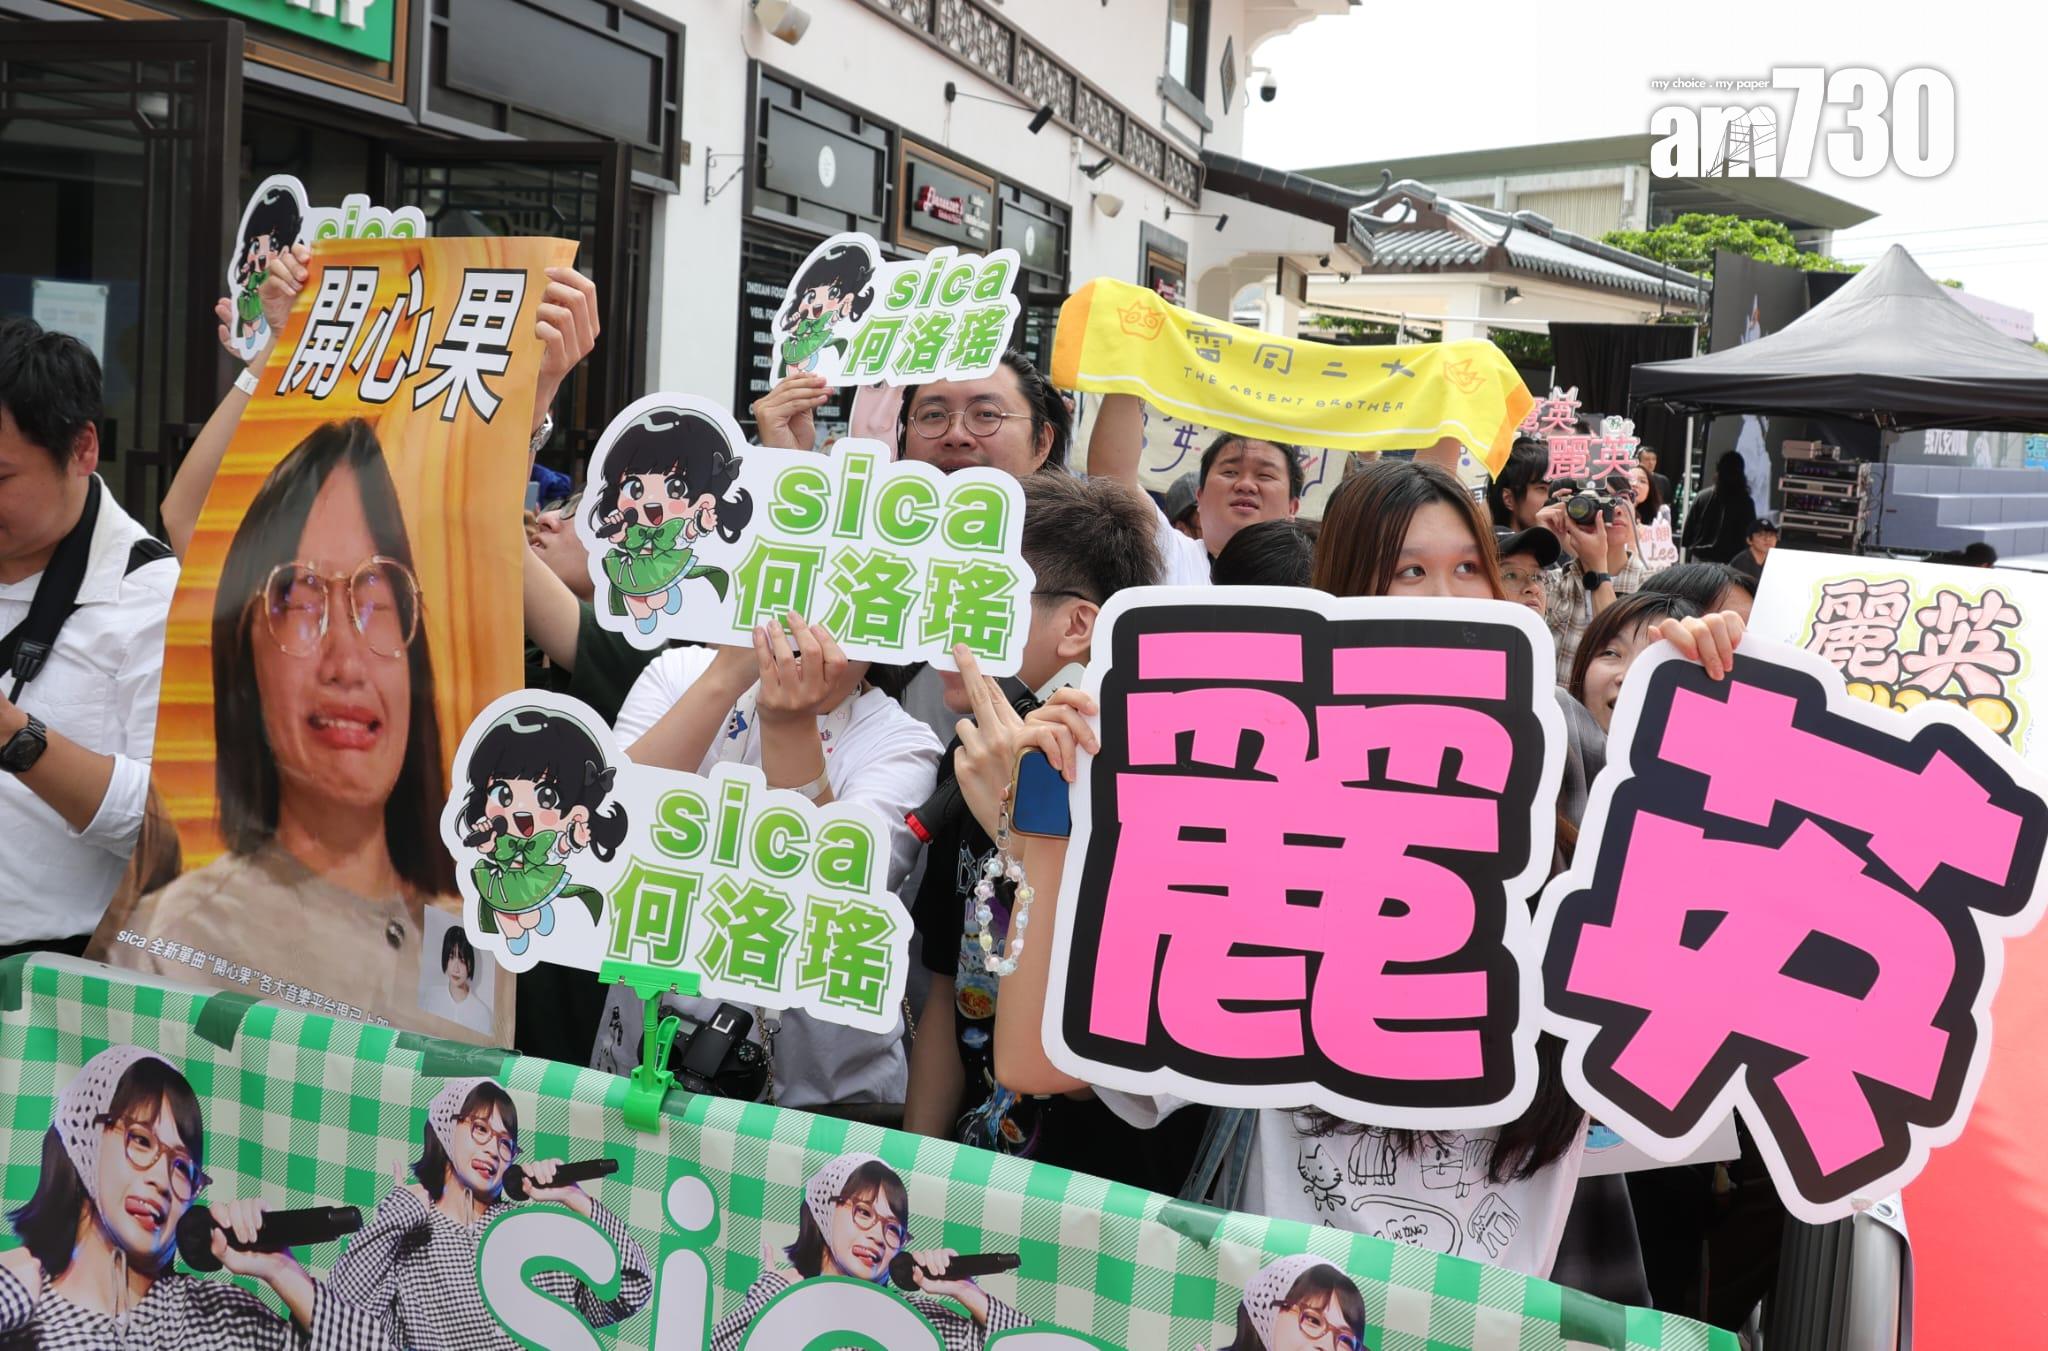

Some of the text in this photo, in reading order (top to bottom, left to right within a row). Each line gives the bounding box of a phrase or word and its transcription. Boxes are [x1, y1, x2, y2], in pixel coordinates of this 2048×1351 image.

[841, 304, 1011, 377] 何洛瑤
[885, 255, 1011, 311] sica
[275, 263, 528, 424] 開心果
[1184, 366, 1217, 384] THE
[768, 453, 1010, 554] sica
[1544, 434, 1641, 481] 麗英
[732, 535, 1018, 660] 何洛瑤
[1803, 578, 2022, 697] 麗英
[650, 779, 875, 894] sica
[1080, 620, 1523, 1090] 麗
[116, 929, 147, 949] sica
[605, 855, 898, 1016] 何洛瑤
[1560, 677, 2024, 1180] 英
